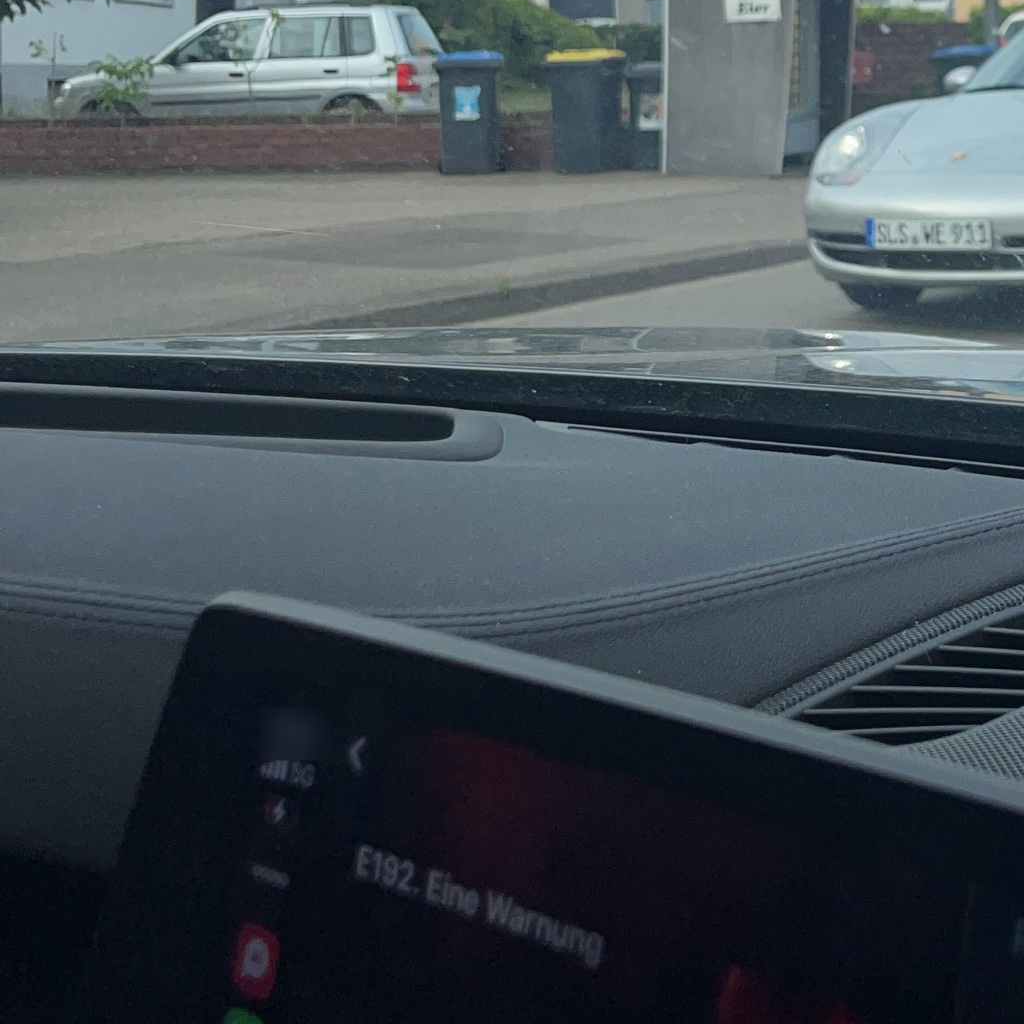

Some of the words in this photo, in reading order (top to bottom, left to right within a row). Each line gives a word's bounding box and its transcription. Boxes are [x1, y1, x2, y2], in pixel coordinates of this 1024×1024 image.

[877, 222, 908, 244] SLS
[920, 222, 945, 244] WE
[951, 222, 987, 244] 911
[425, 868, 480, 917] Eine
[485, 888, 605, 970] Warnung
